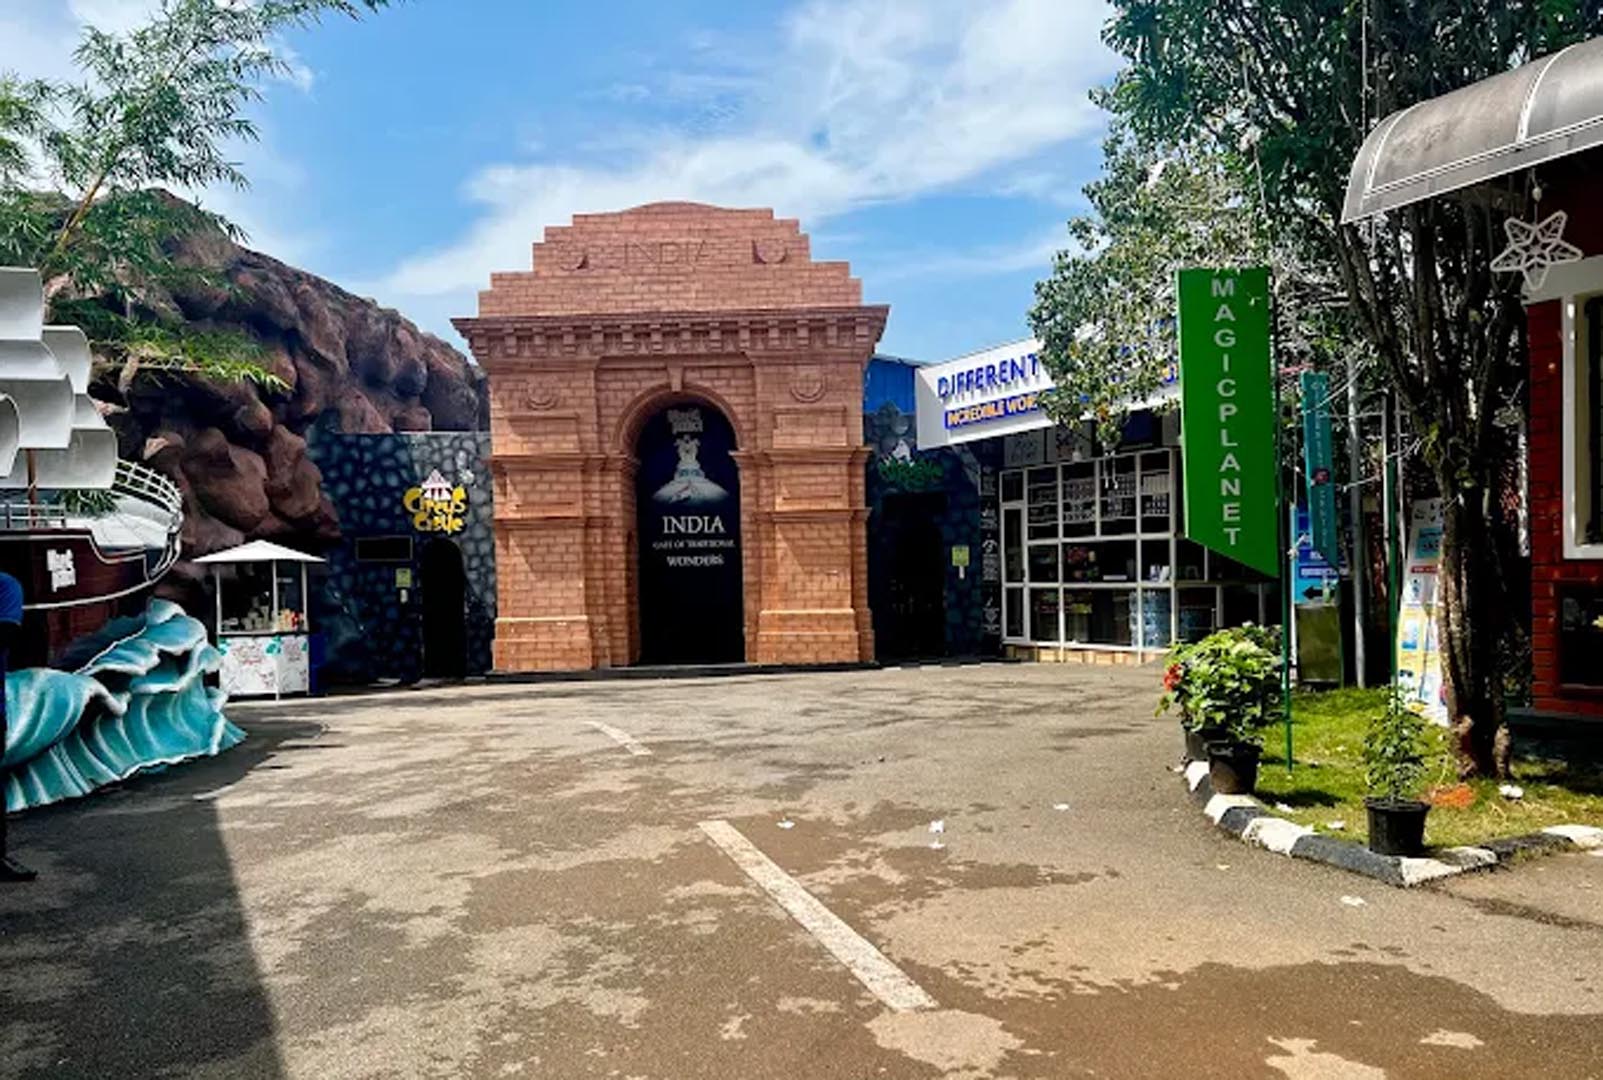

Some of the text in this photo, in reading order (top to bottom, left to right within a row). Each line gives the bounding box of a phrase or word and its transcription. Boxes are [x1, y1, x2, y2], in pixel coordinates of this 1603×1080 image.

[623, 239, 712, 265] INDIA
[937, 352, 1038, 398] DIFFERENT
[947, 394, 1038, 426] INCREDIBLE WOR
[1210, 278, 1241, 546] MAGICPLANET
[662, 515, 726, 534] INDIA
[667, 555, 725, 567] WONDERS
